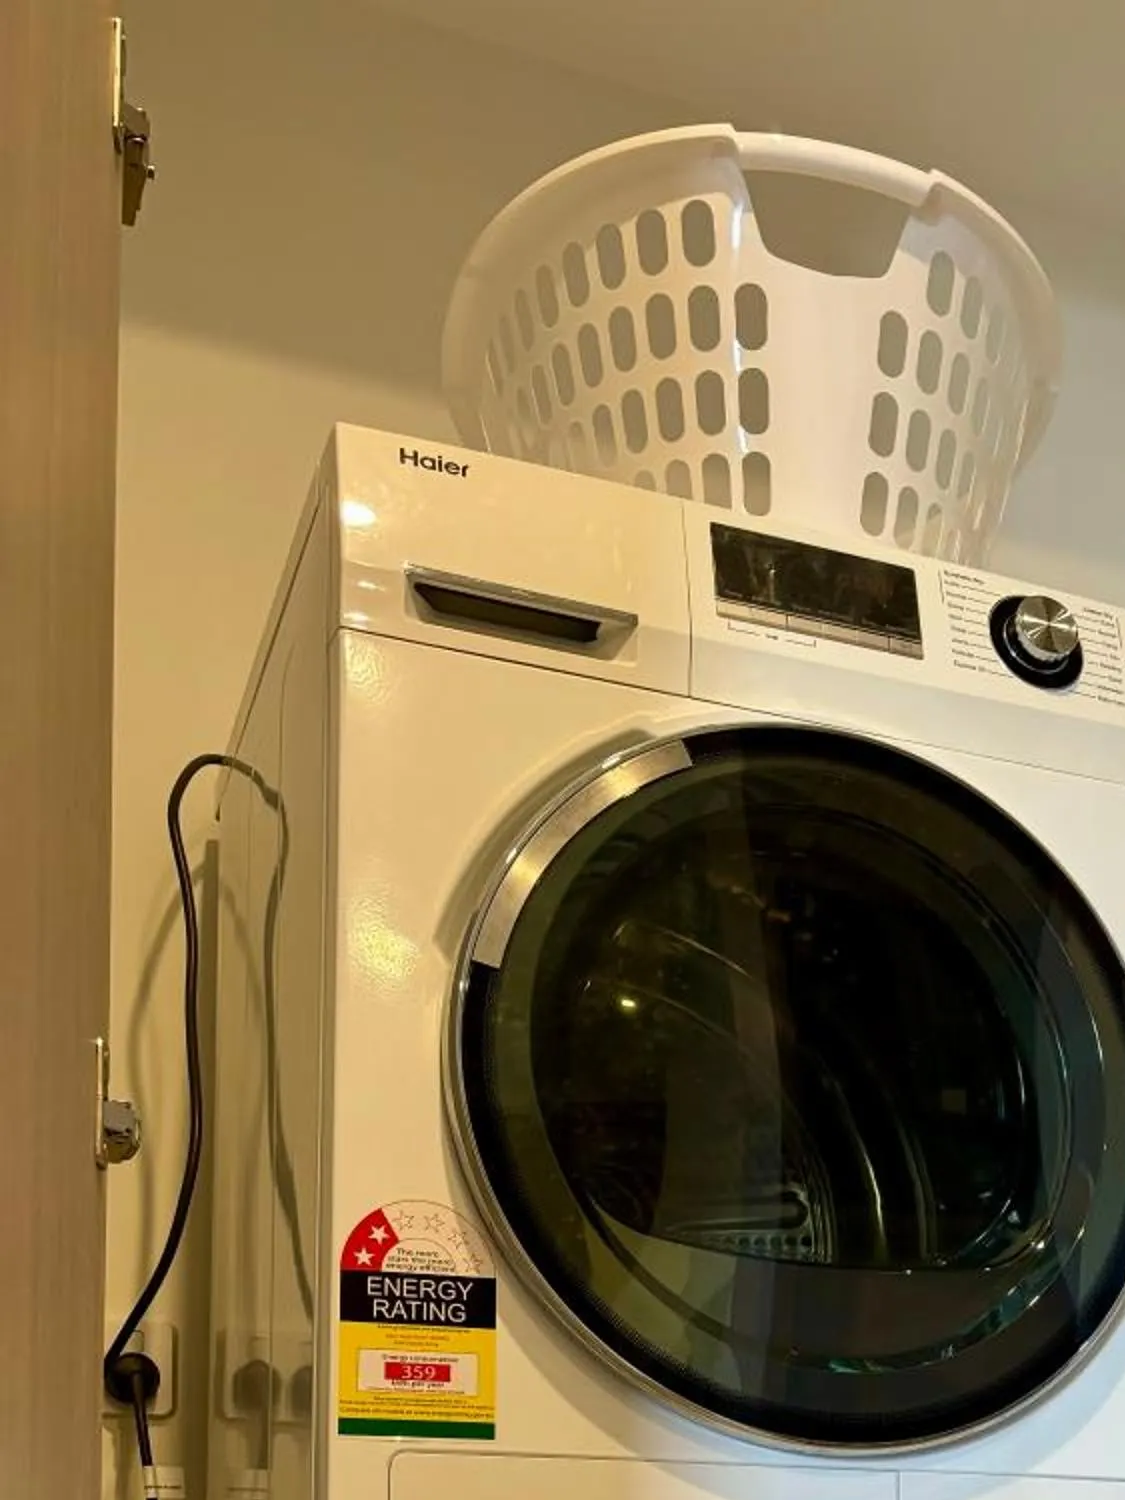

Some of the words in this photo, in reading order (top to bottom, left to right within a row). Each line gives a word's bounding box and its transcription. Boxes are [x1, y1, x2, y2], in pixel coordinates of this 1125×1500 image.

[399, 447, 470, 477] Haier
[366, 1276, 474, 1301] ENERGY
[372, 1299, 467, 1323] RATING
[401, 1365, 437, 1380] 359
